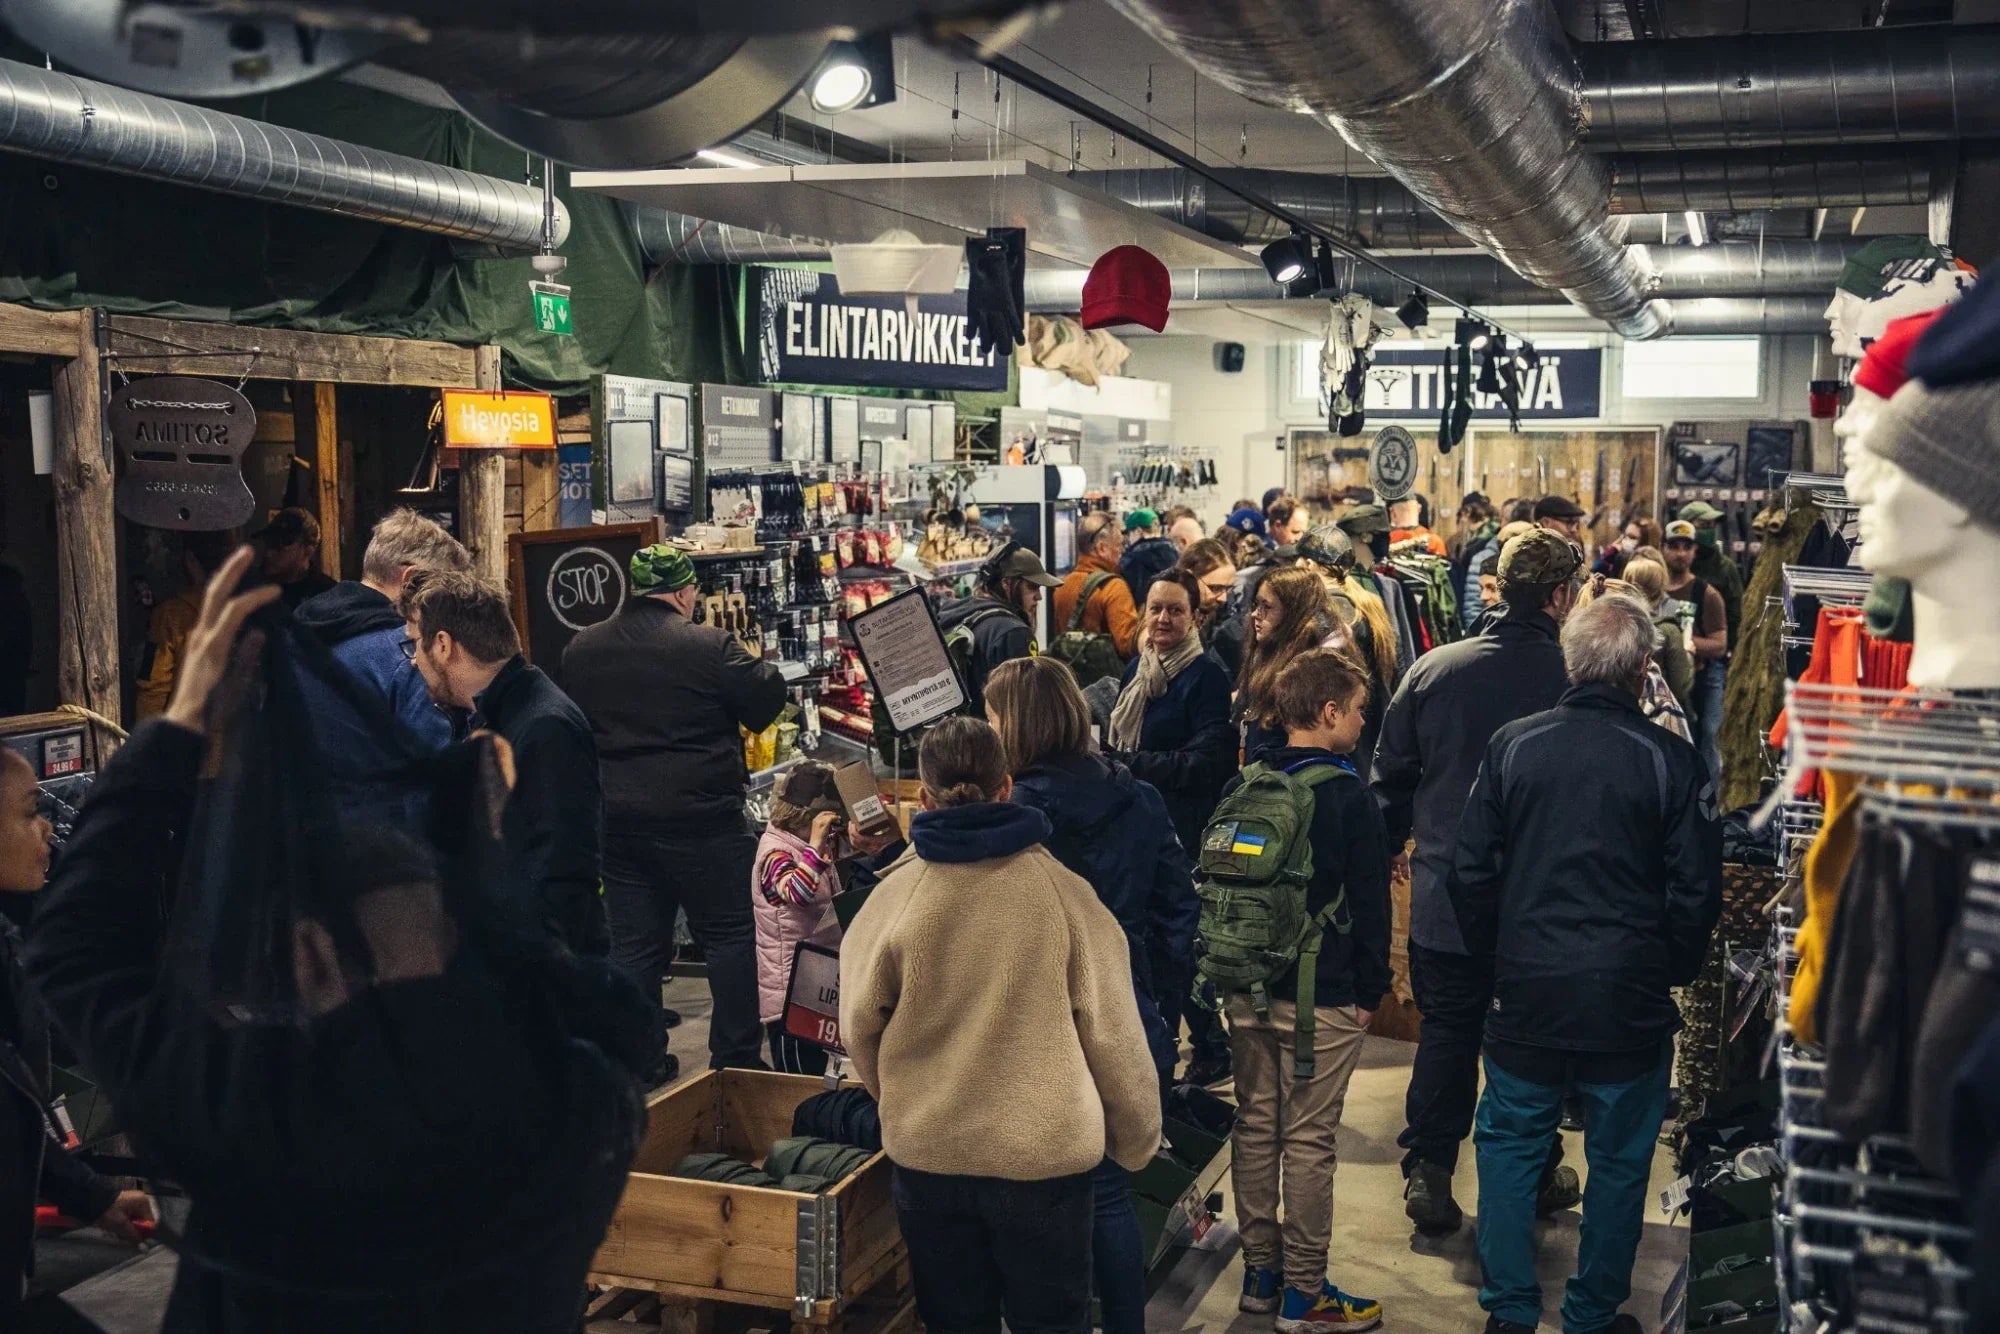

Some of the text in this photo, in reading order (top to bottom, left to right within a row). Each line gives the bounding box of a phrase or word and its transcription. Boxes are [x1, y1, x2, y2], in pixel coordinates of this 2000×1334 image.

[786, 301, 995, 367] ELINTARVIKKEE
[461, 403, 541, 433] Hevosia
[557, 563, 610, 609] STOP
[818, 986, 840, 1006] LIP
